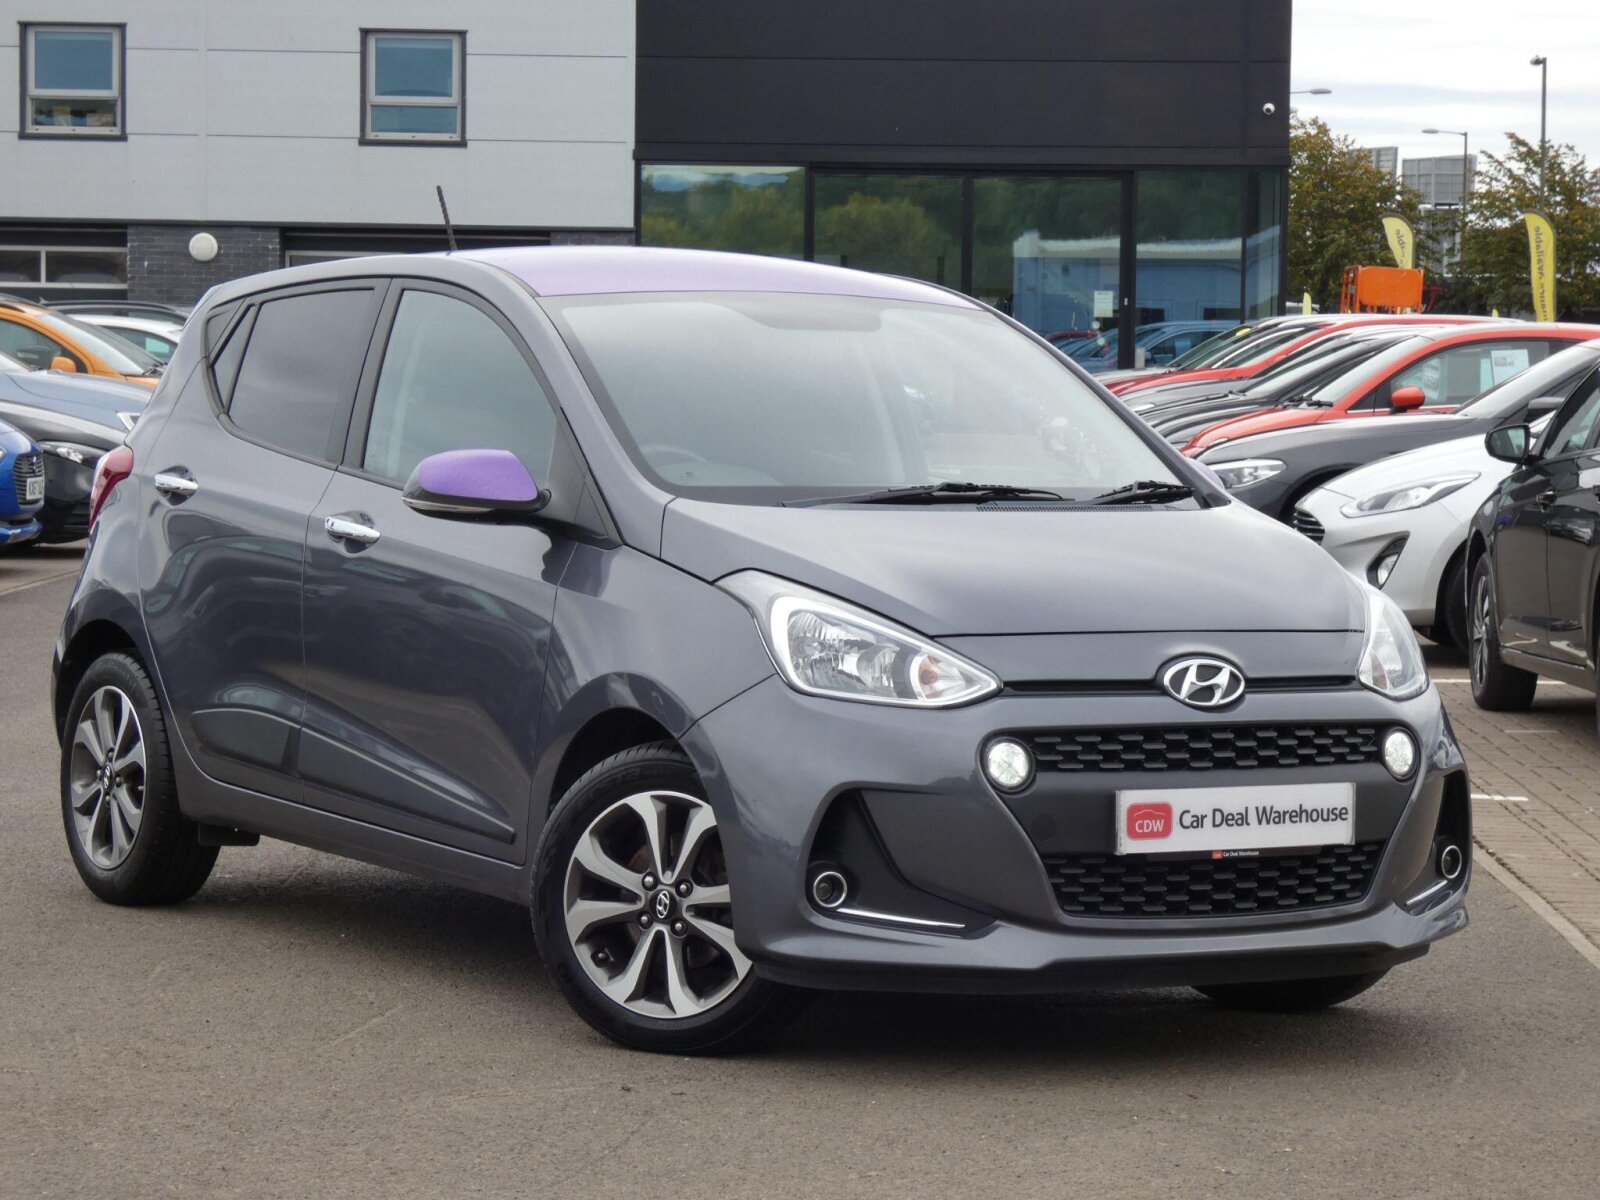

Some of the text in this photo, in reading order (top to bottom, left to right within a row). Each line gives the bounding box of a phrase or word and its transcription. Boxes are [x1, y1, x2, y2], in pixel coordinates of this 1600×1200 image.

[1135, 819, 1164, 833] CDW
[1179, 804, 1349, 830] Car Deal Warehouse
